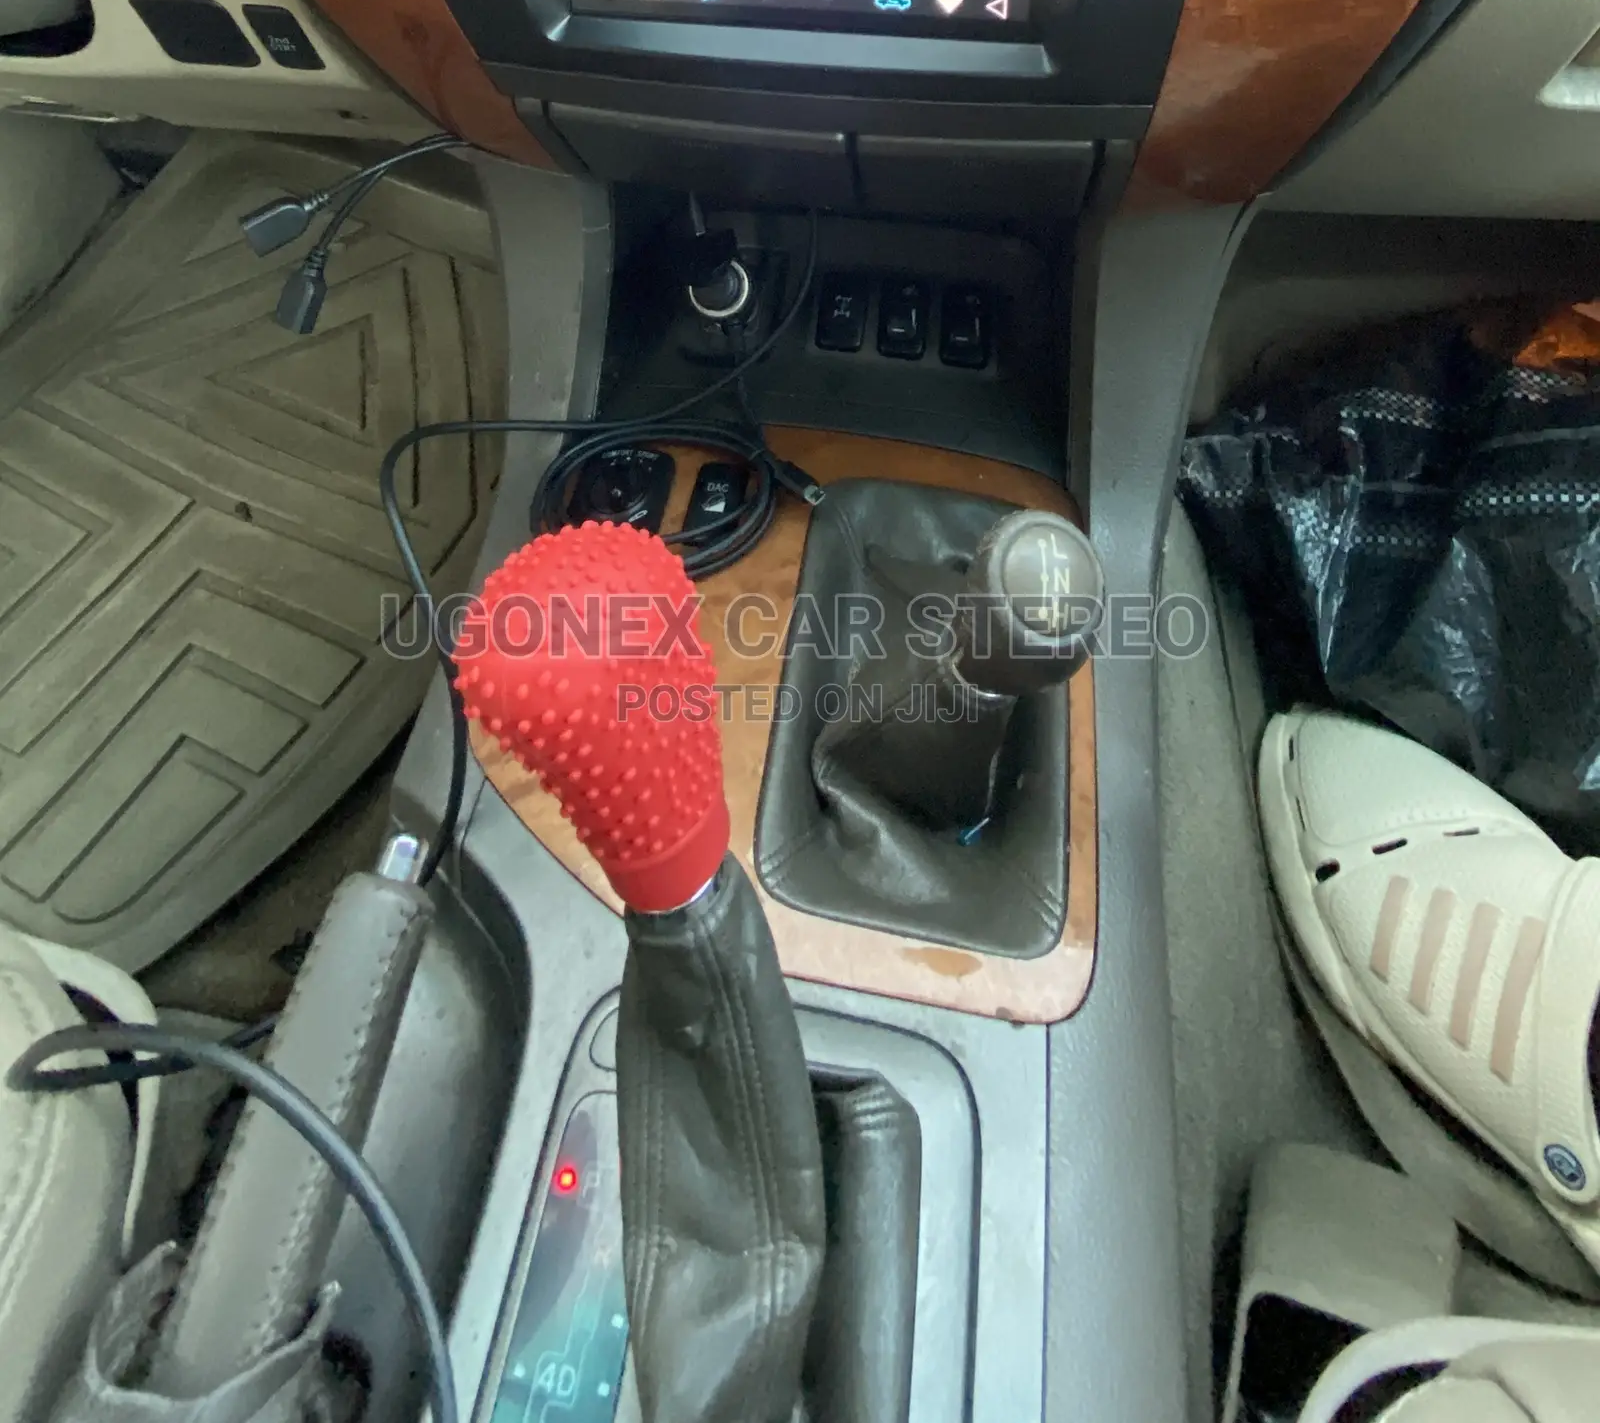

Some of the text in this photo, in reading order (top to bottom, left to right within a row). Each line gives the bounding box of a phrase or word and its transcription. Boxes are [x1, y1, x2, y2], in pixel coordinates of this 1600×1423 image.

[706, 481, 730, 493] DAC
[1050, 532, 1069, 559] L
[1053, 566, 1071, 594] N
